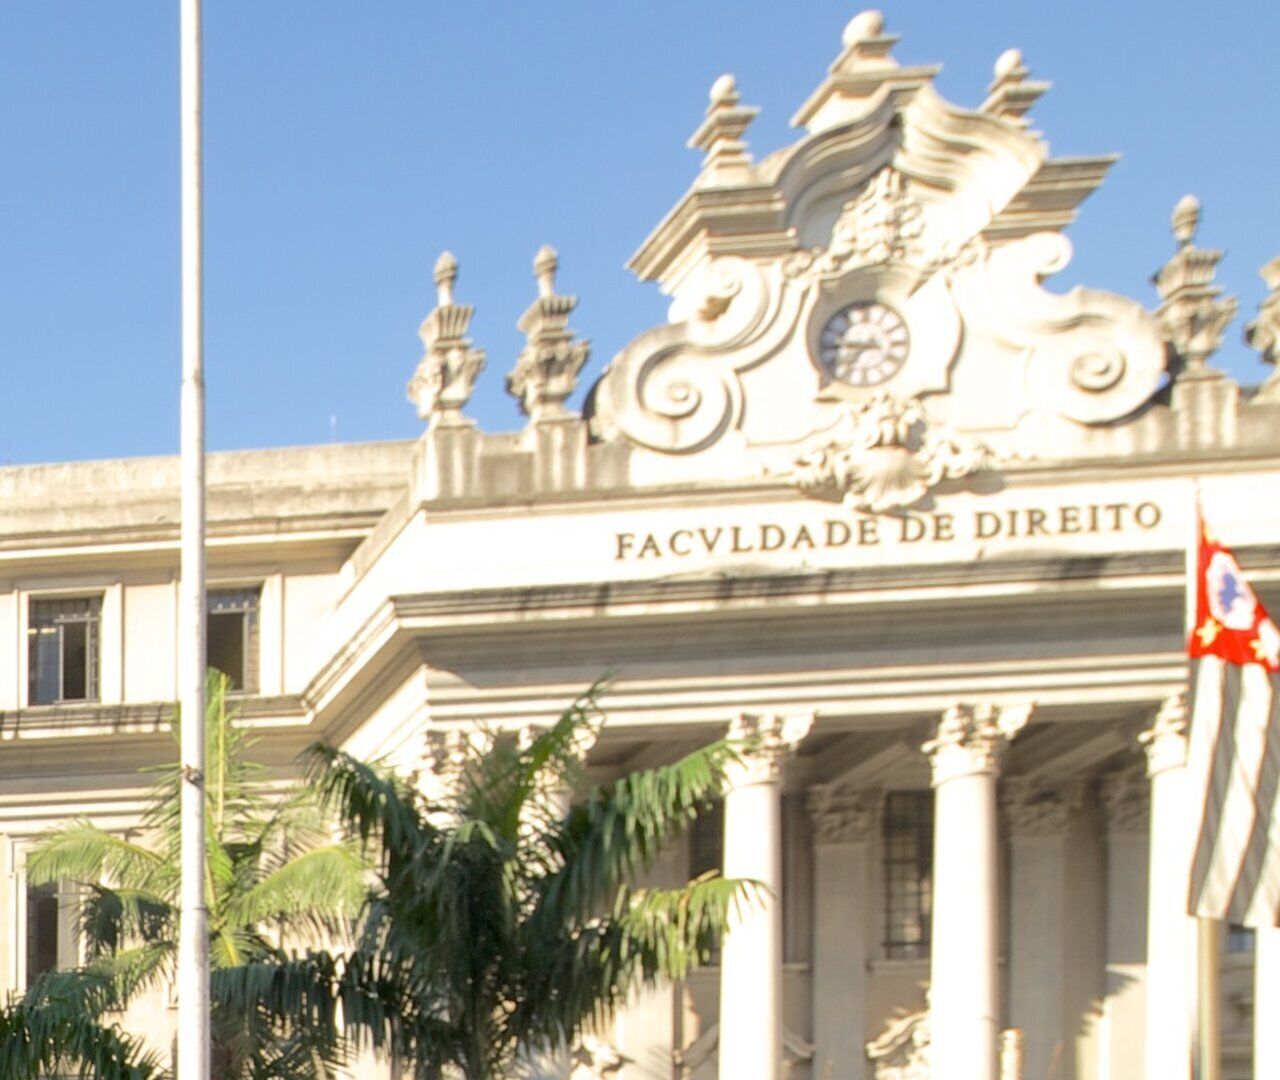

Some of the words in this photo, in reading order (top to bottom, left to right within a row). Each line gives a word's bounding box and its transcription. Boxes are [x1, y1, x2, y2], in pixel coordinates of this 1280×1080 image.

[614, 517, 880, 560] FACVLDADE
[899, 513, 954, 543] DE
[974, 502, 1162, 539] DIREITO
